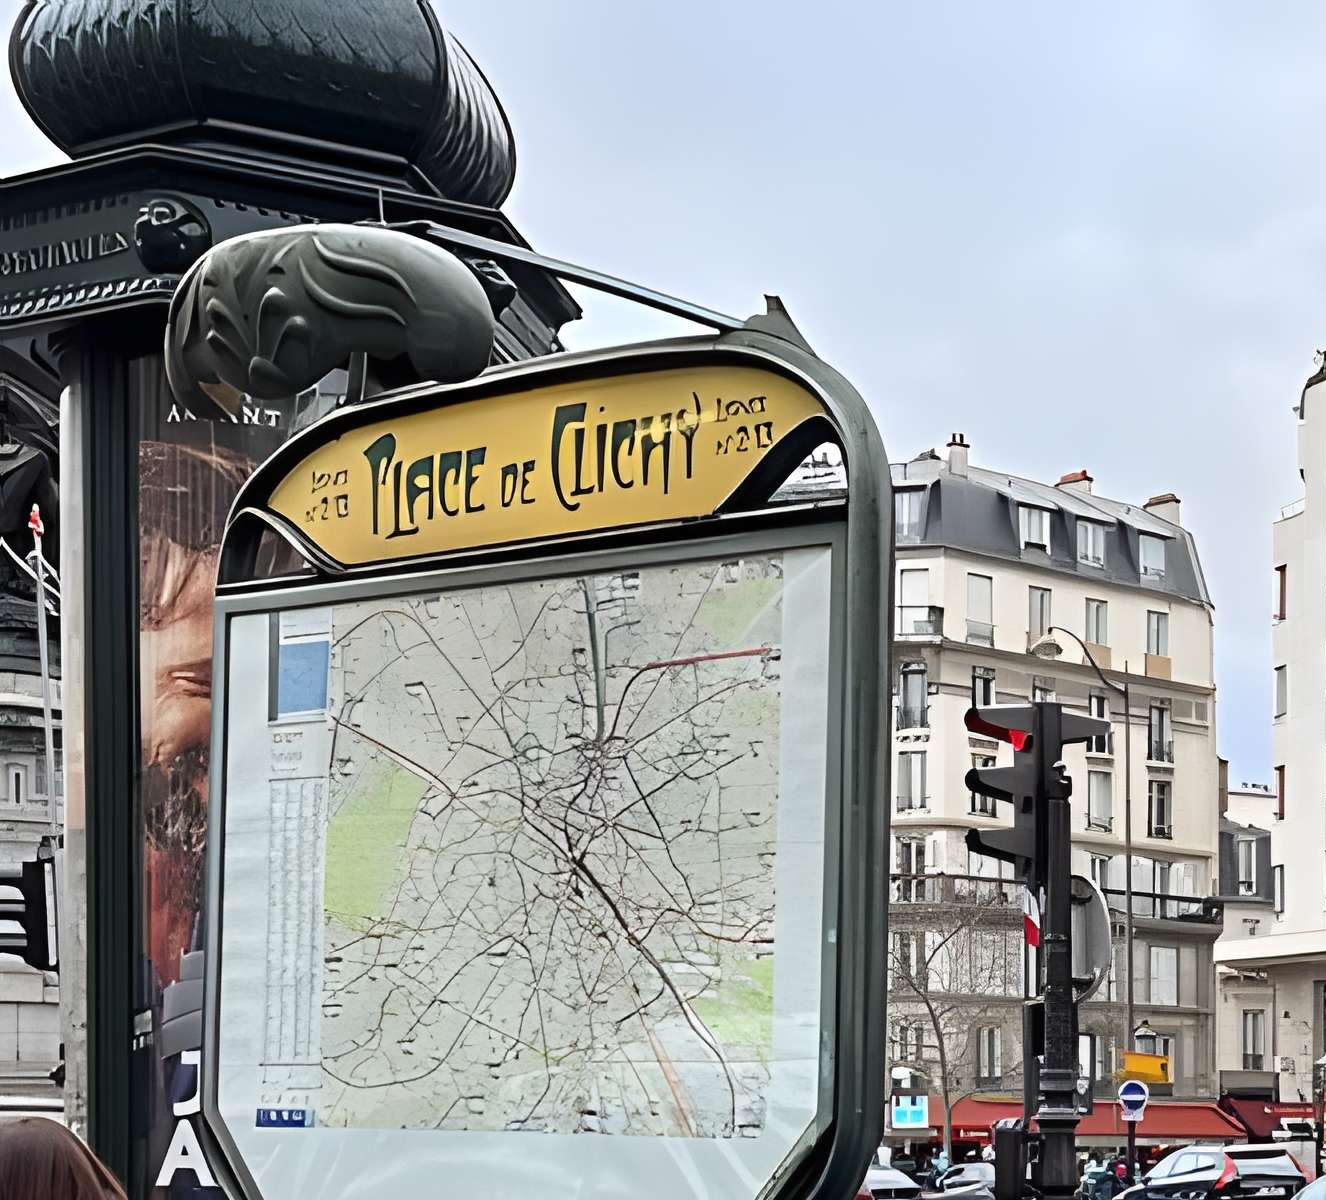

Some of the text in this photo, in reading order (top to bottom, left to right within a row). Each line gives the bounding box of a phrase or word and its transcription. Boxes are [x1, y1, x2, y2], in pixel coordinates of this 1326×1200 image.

[362, 432, 487, 540] PLACE
[500, 459, 536, 508] DE
[551, 391, 702, 512] CLICHY
